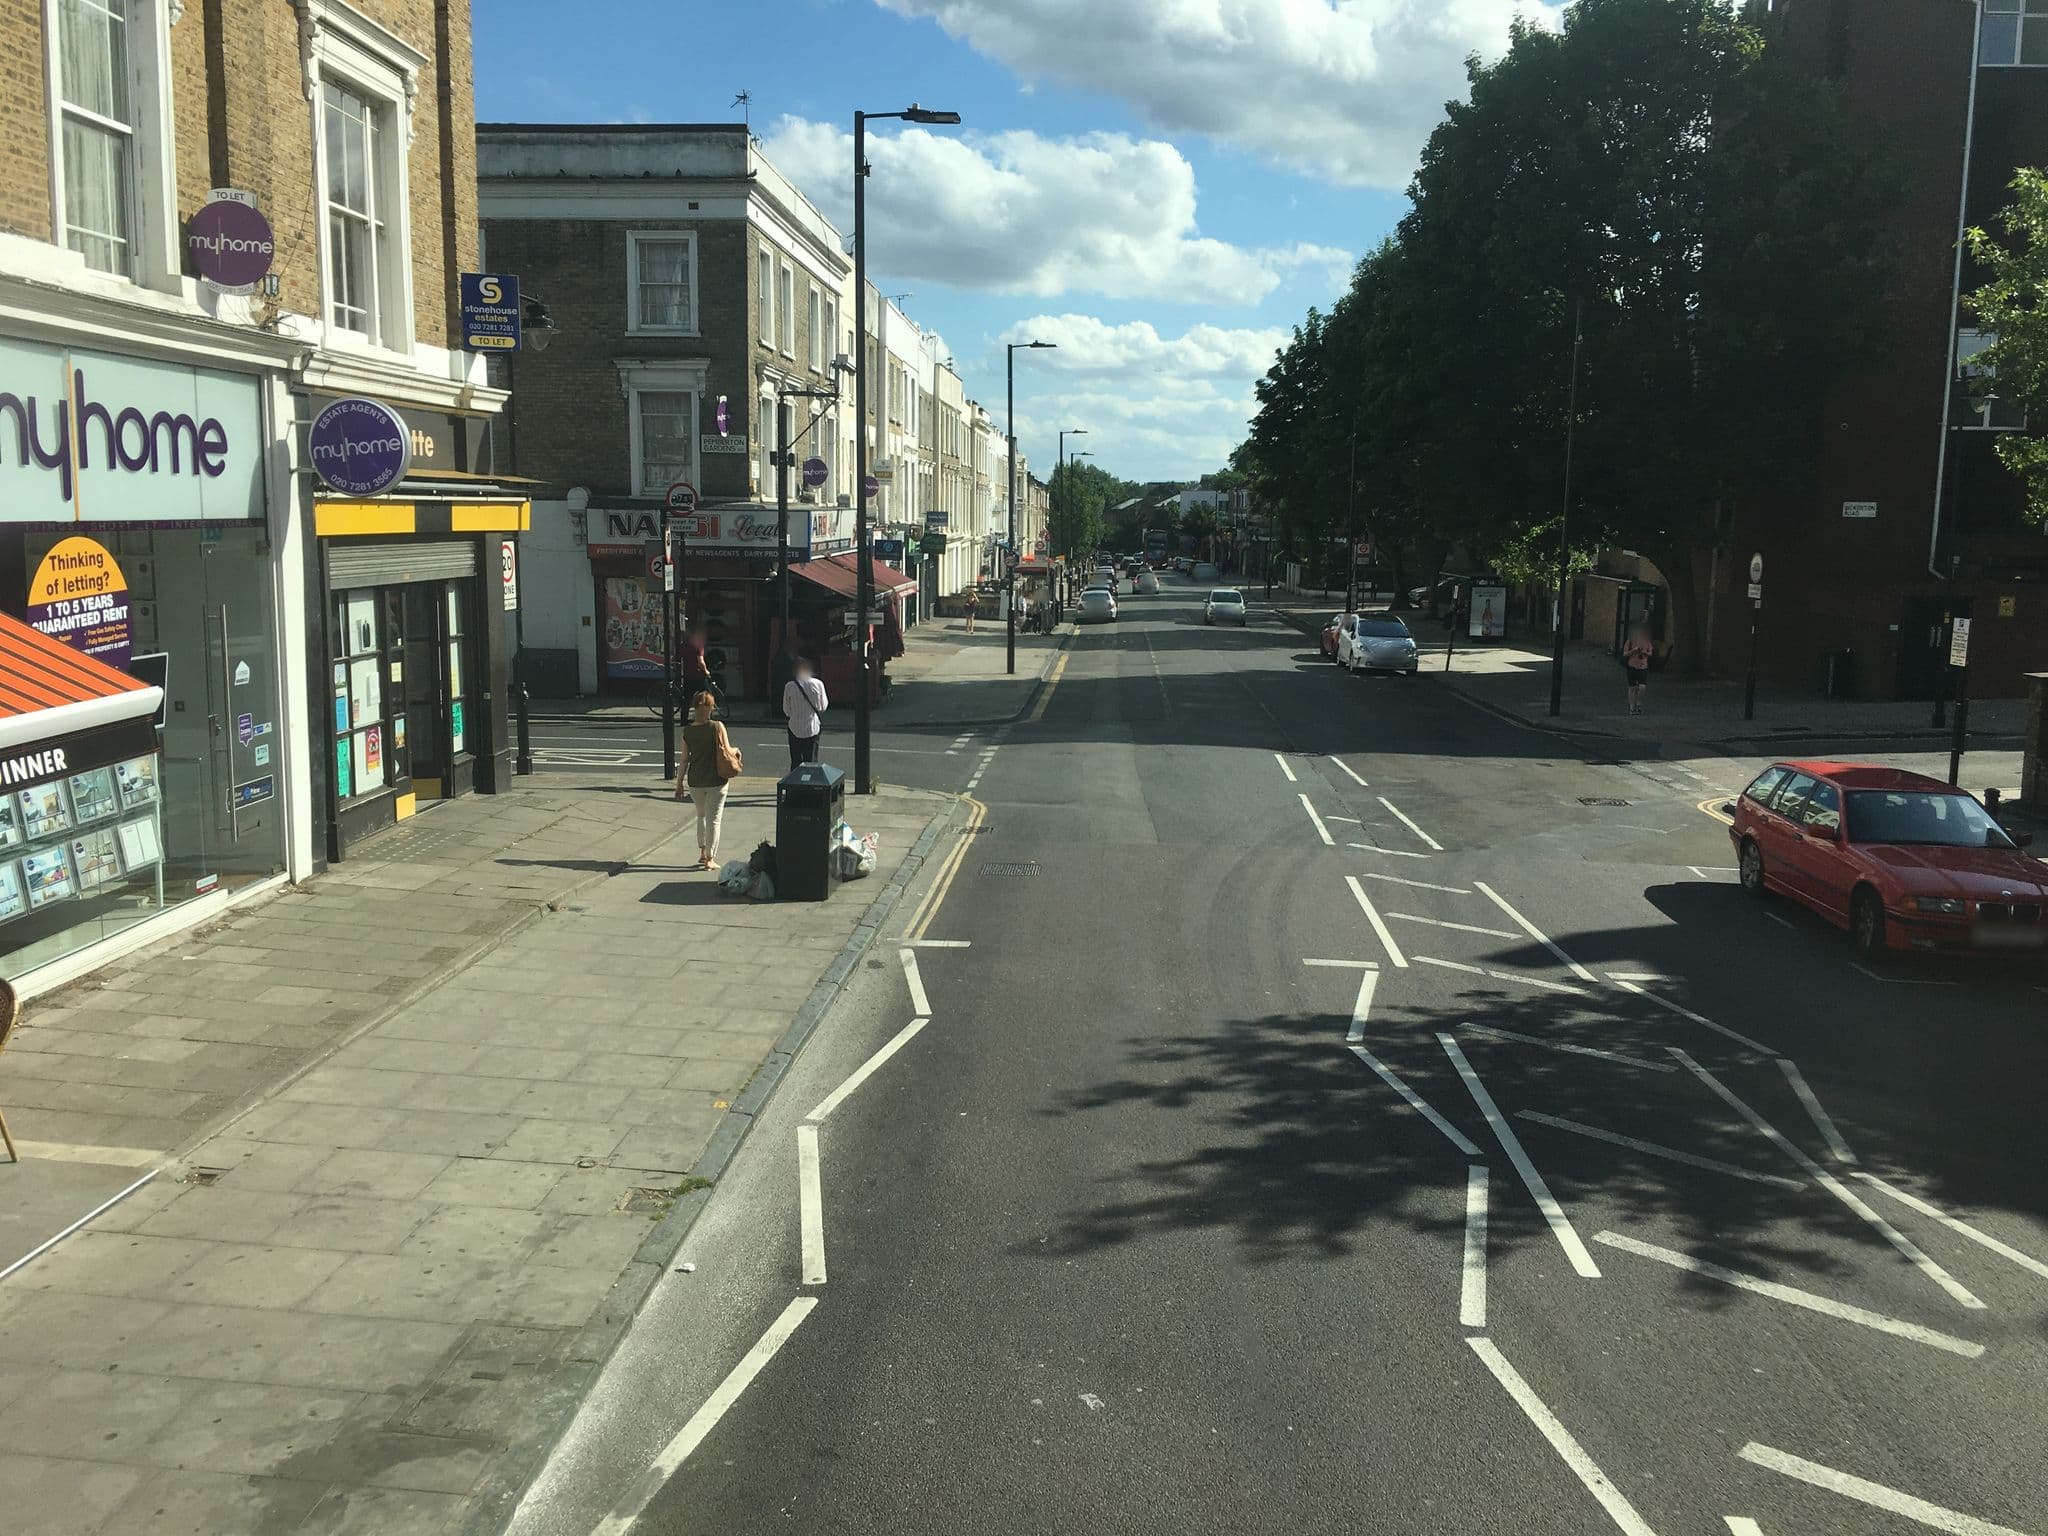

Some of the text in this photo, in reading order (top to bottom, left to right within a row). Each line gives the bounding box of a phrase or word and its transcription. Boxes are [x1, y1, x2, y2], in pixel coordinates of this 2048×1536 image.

[216, 191, 228, 199] TO
[188, 233, 272, 255] myhome
[464, 305, 518, 315] stonehouse
[474, 314, 508, 322] estates
[478, 337, 506, 346] TO LET
[319, 403, 387, 429] ESTATE AGENTS
[313, 437, 401, 462] myhome
[330, 468, 393, 491] 020 7281 3565
[608, 514, 721, 538] NASI
[49, 551, 104, 571] Thinking
[46, 571, 110, 596] of letting?
[47, 594, 114, 618] 1 TO 5 YEARS
[103, 606, 128, 623] RENT
[0, 748, 68, 785] INNER
